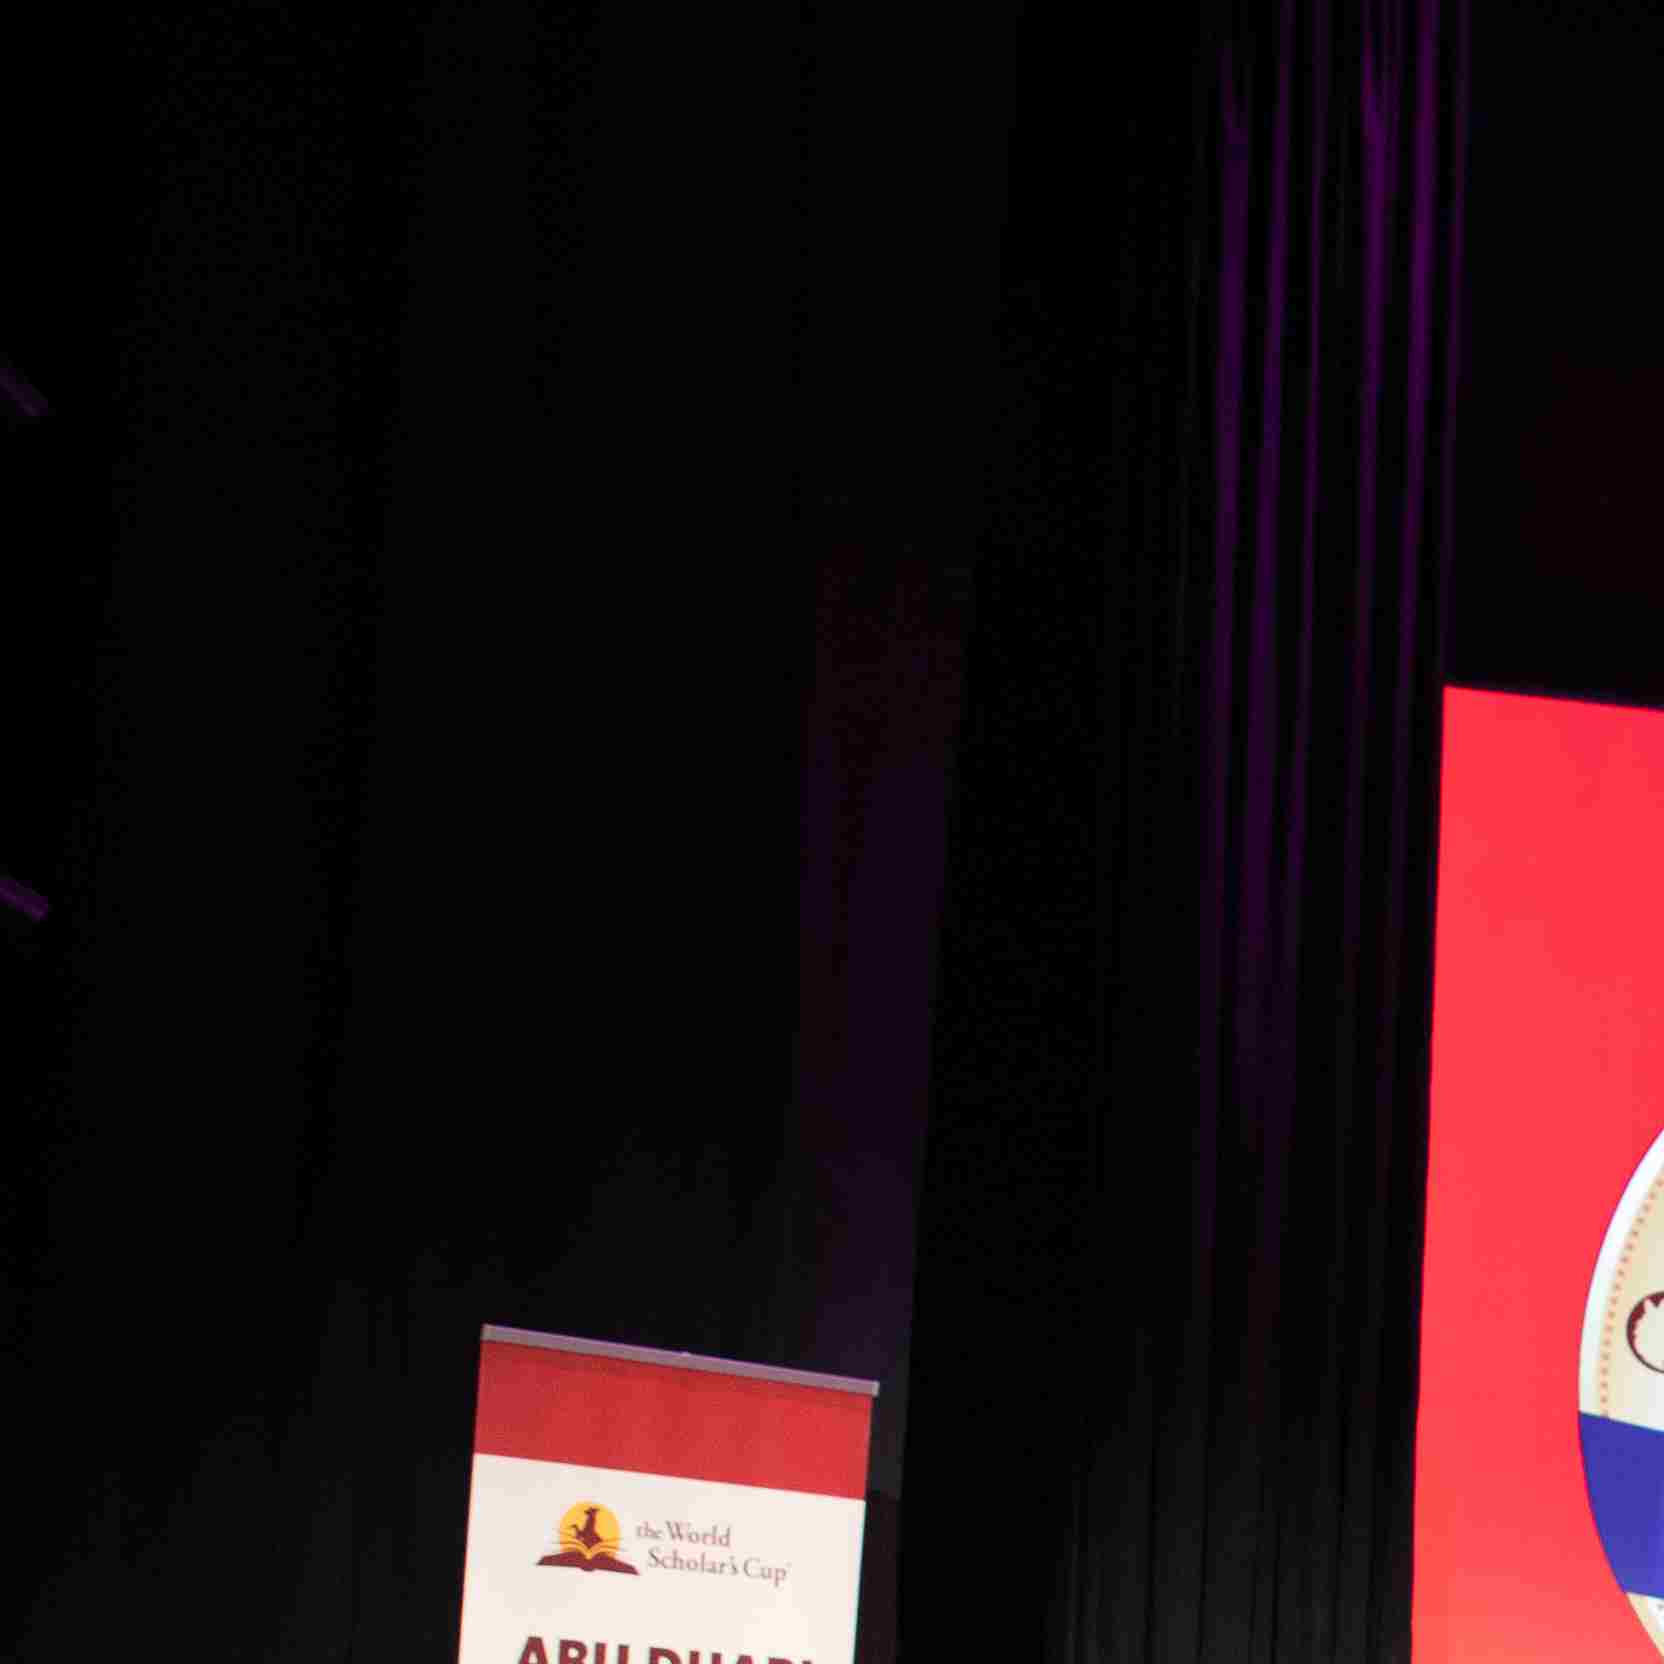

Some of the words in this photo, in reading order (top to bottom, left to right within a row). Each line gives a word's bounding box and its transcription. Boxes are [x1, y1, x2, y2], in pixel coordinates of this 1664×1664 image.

[636, 1520, 663, 1540] the
[665, 1520, 732, 1549] World
[743, 1557, 787, 1588] Cup
